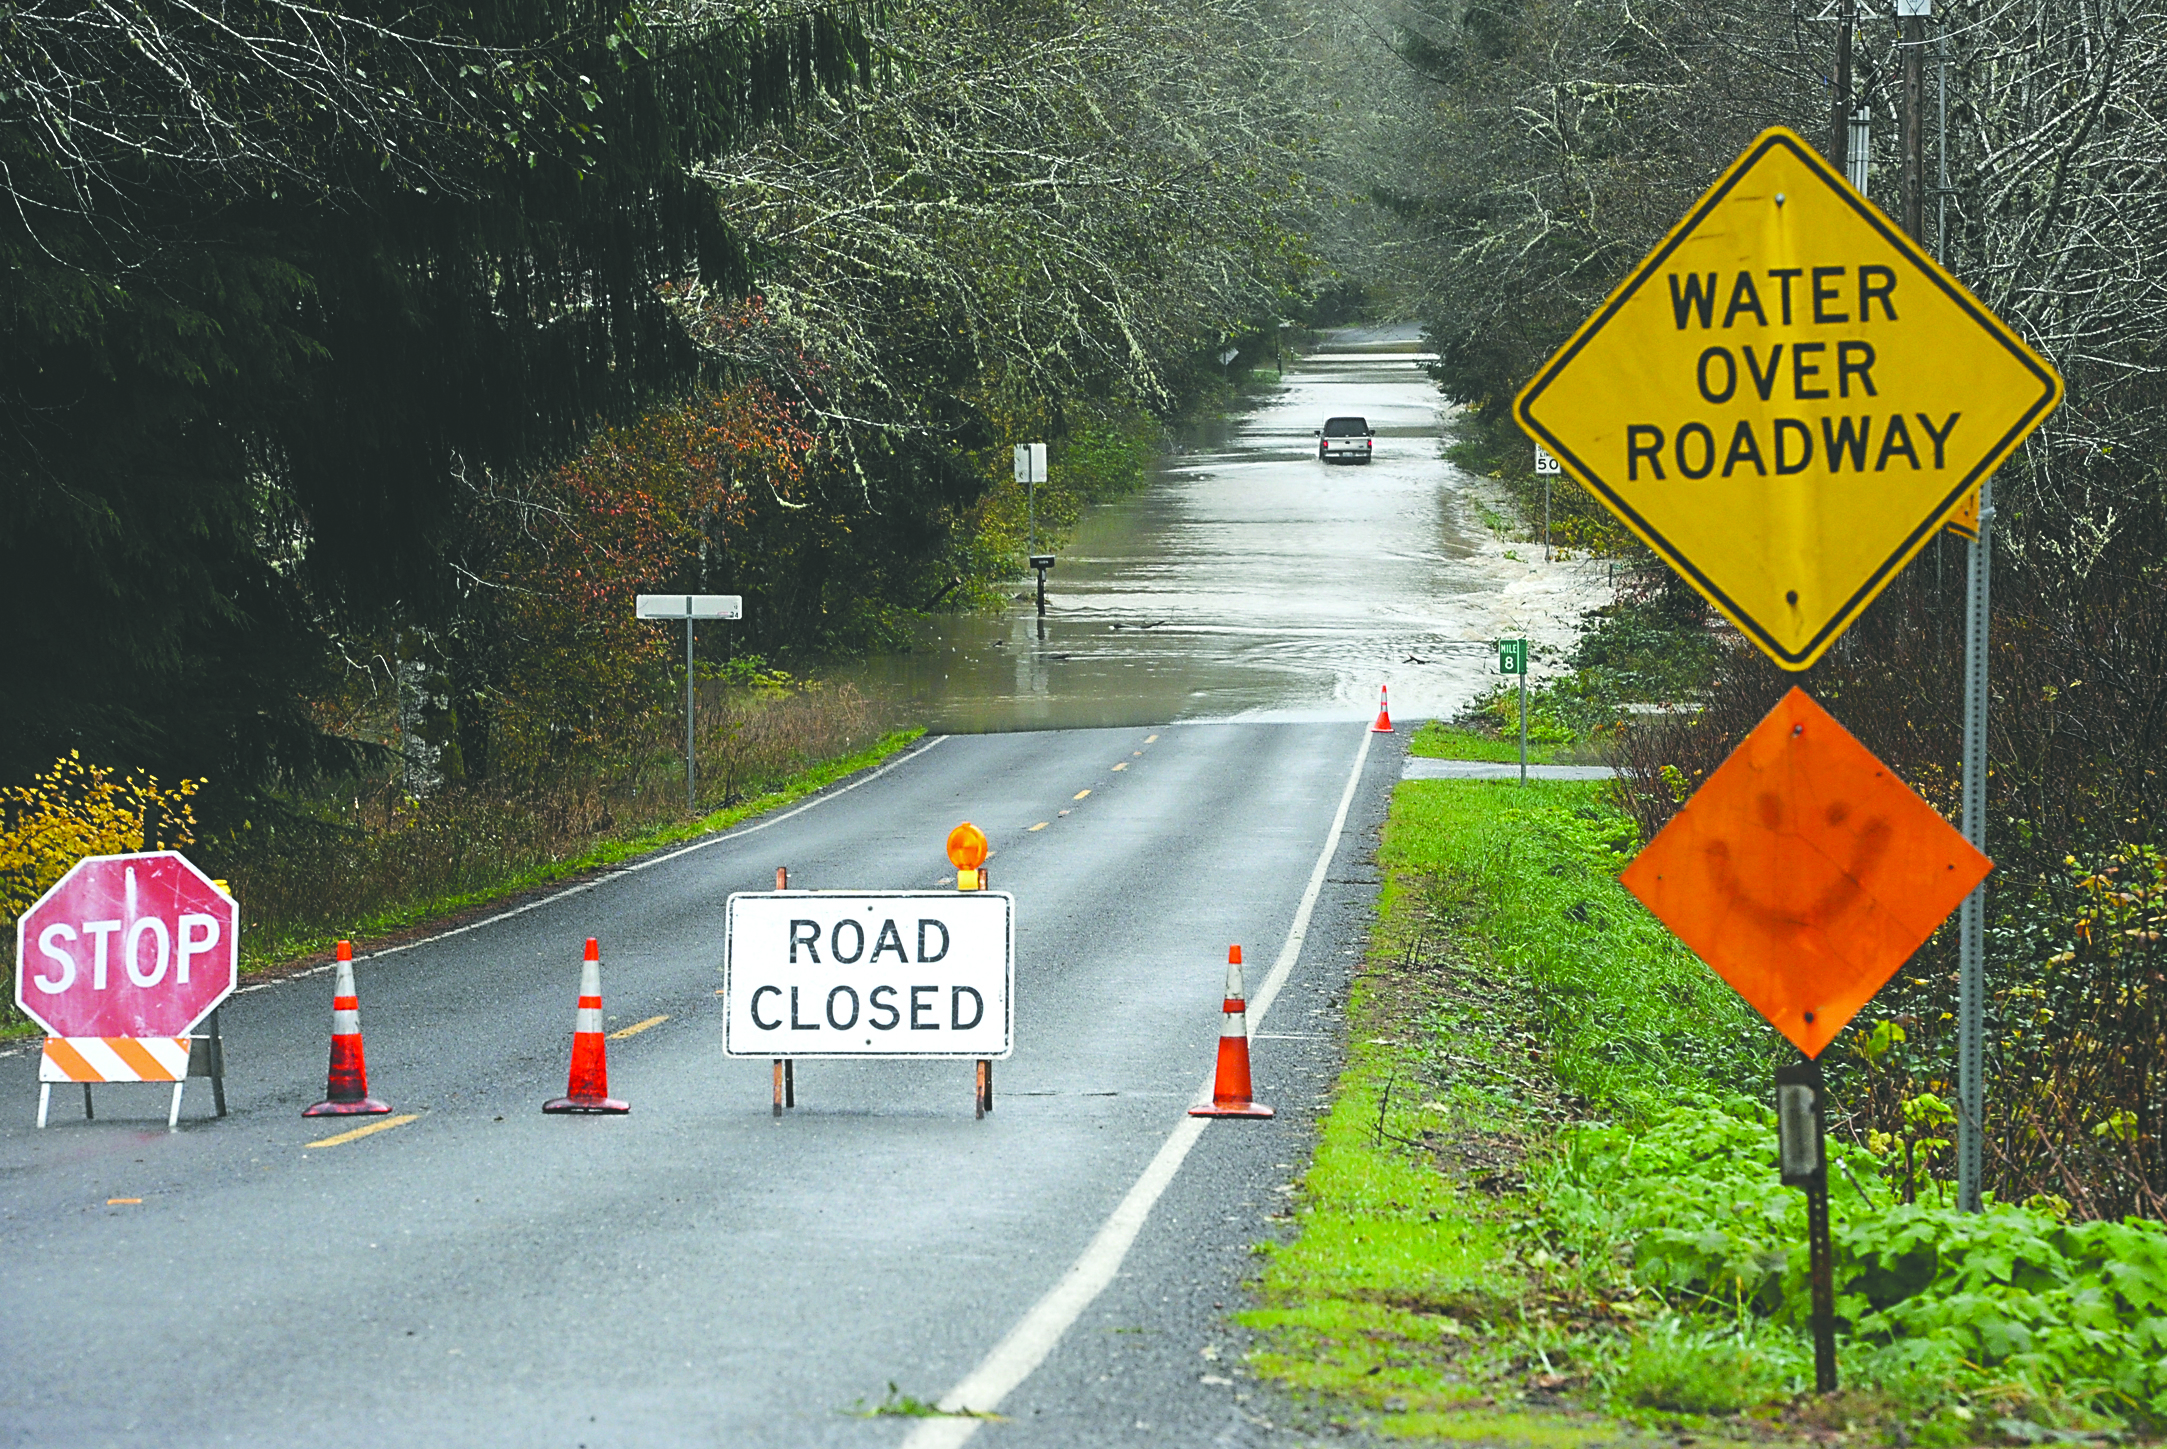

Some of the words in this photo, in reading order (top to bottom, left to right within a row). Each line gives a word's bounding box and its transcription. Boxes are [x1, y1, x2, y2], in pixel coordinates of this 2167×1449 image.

[1668, 264, 1899, 331] WATER
[1697, 340, 1878, 405] OVER
[1538, 458, 1558, 470] 50
[1626, 412, 1962, 482] ROADWAY
[1501, 644, 1517, 654] MILE
[1505, 656, 1514, 670] 8
[34, 912, 220, 994] STOP
[789, 918, 950, 964] ROAD
[751, 985, 984, 1031] CLOSED
